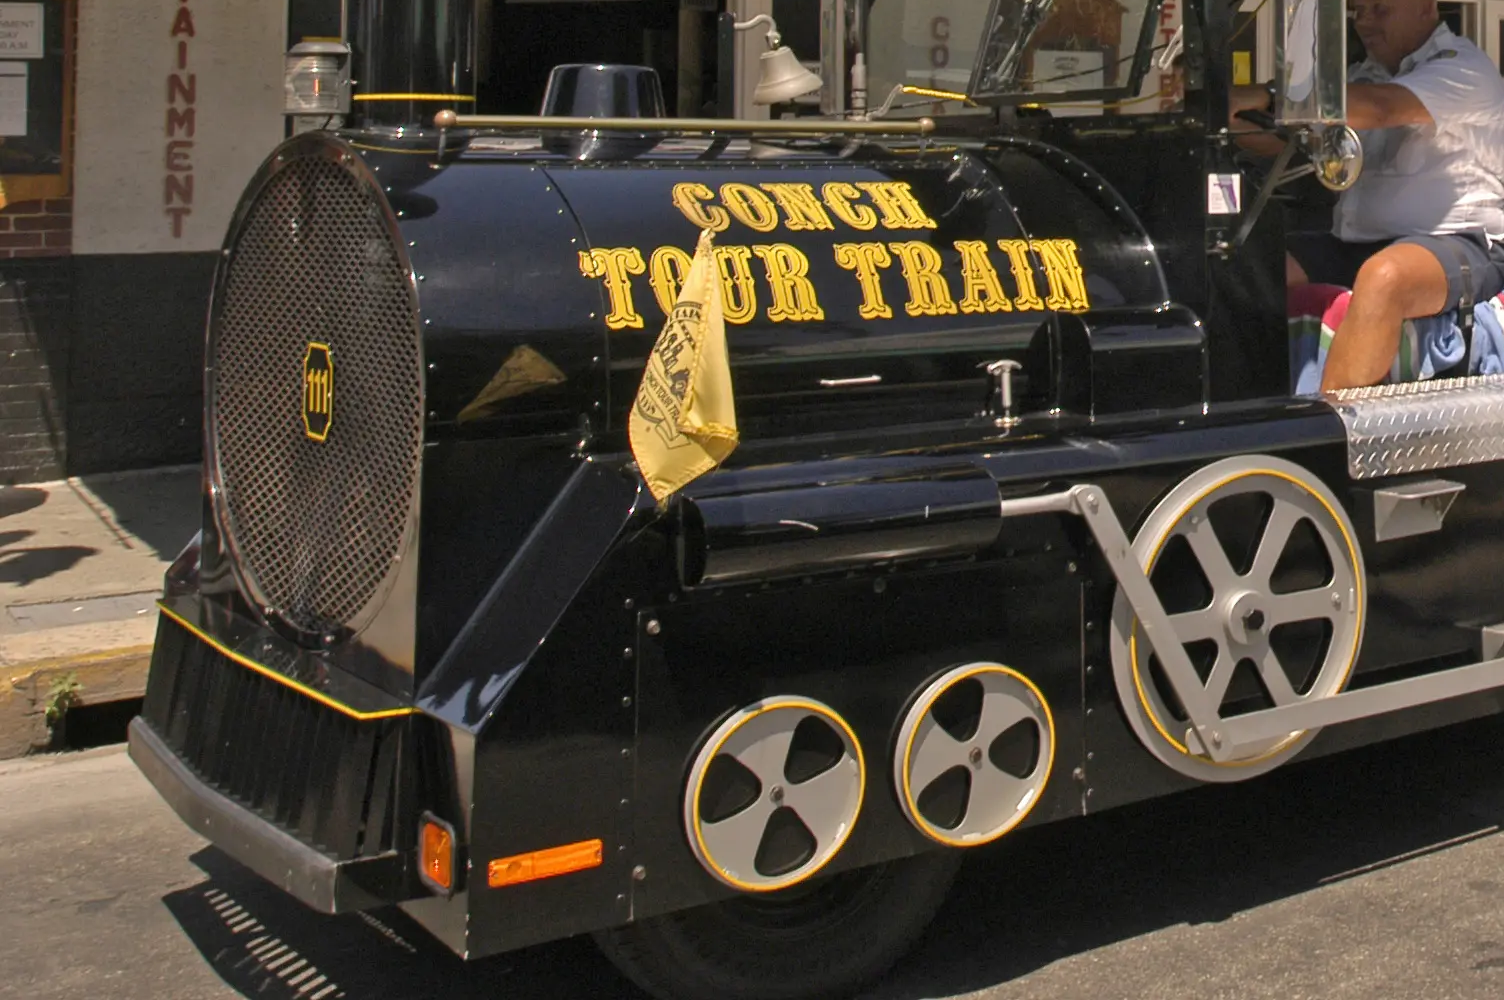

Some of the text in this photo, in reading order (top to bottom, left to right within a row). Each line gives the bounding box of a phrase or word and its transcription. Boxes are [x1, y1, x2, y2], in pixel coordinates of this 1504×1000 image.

[671, 181, 938, 234] CONCH
[578, 239, 1091, 331] TOUR TRAIN
[307, 367, 329, 415] 111
